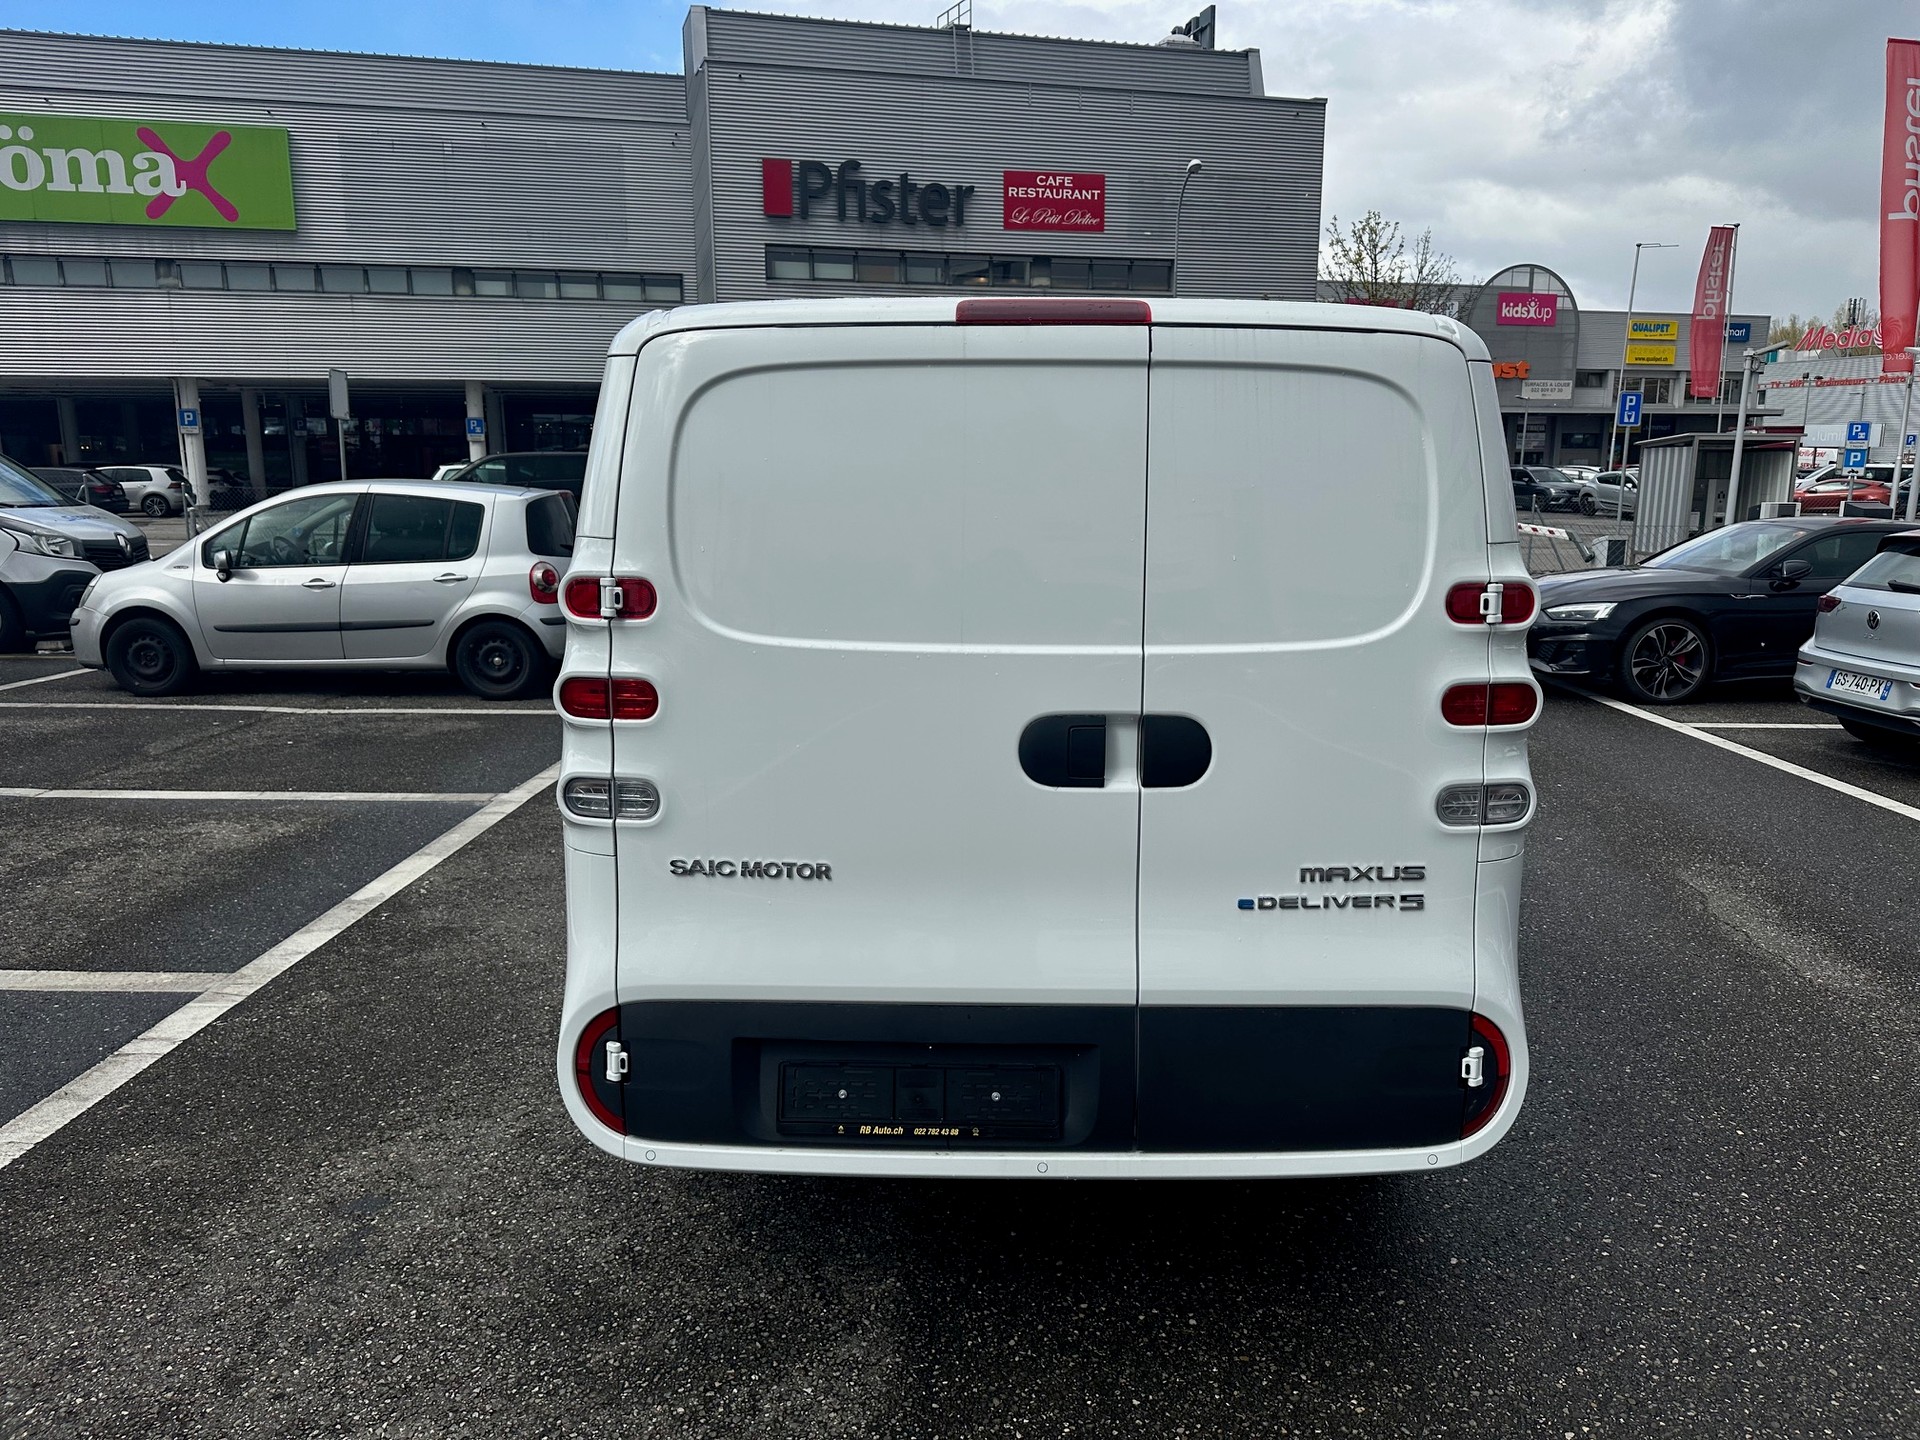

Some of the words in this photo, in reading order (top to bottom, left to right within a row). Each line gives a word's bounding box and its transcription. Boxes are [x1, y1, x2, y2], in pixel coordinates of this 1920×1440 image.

[1036, 175, 1074, 187] CAFE
[799, 159, 975, 227] Pfister
[1008, 187, 1101, 200] RESTAURANT
[1031, 208, 1062, 224] Petit
[1631, 322, 1670, 333] QUALIPET
[1795, 325, 1874, 351] Media
[1770, 381, 1781, 389] TV
[1878, 374, 1906, 384] Photo
[1626, 395, 1636, 411] P
[184, 412, 193, 425] P
[470, 420, 478, 430] P
[1852, 424, 1861, 436] P
[1849, 452, 1861, 466] P
[669, 859, 737, 878] SAIC
[740, 860, 832, 880] MOTOR
[1300, 865, 1426, 883] MAXUS
[859, 1125, 871, 1134] RB
[872, 1125, 904, 1135] Auto.ch
[927, 1128, 940, 1136] 782
[940, 1128, 949, 1136] 43
